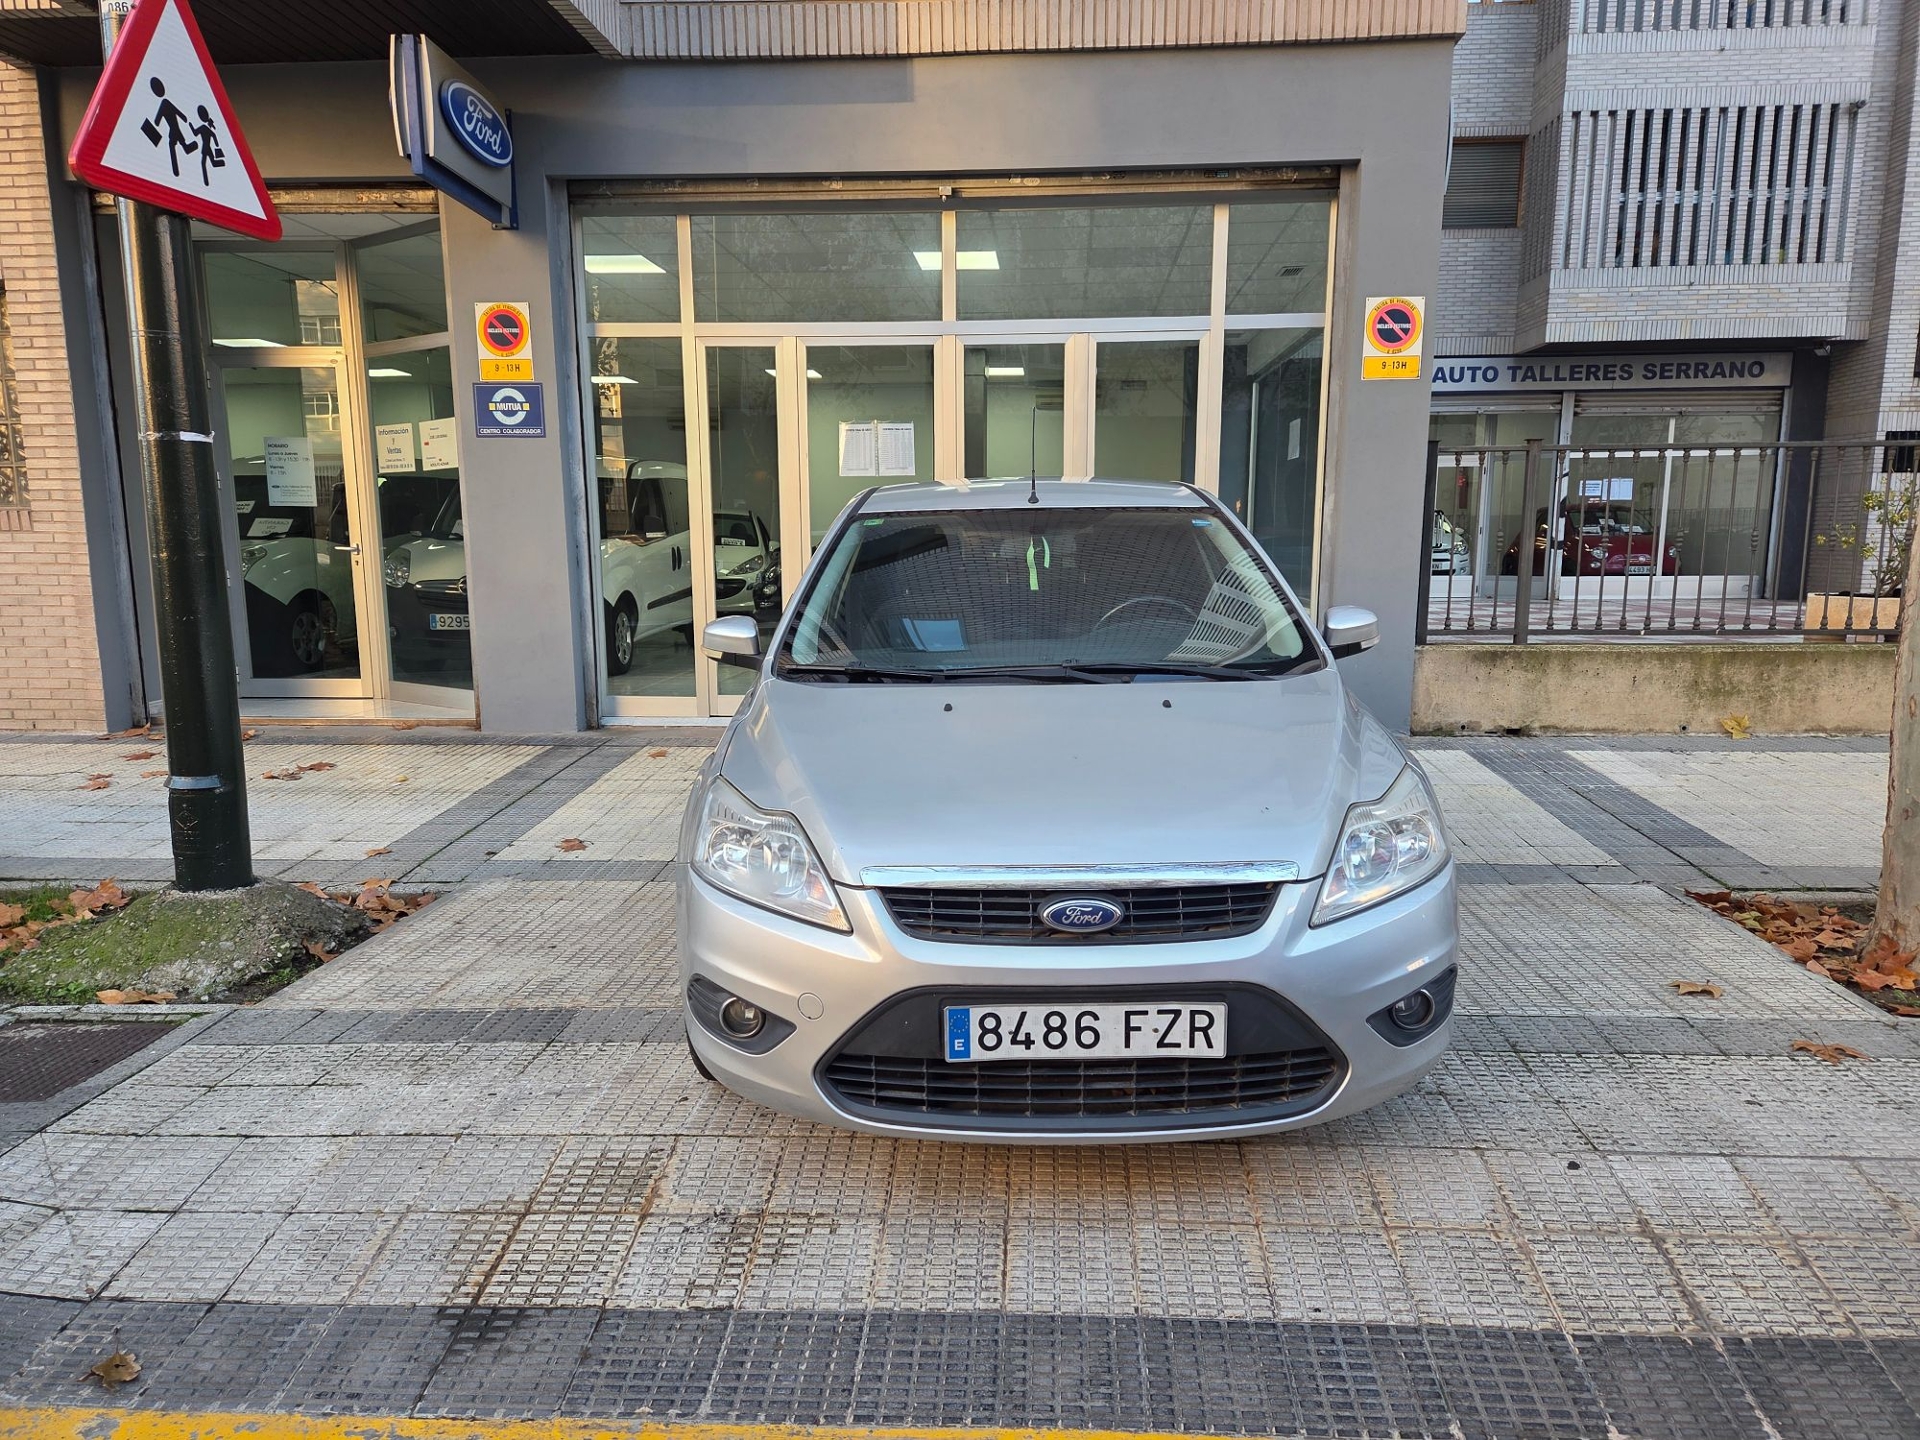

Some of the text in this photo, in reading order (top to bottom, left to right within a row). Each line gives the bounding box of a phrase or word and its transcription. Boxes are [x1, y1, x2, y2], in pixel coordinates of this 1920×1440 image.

[463, 95, 502, 154] Ford
[1432, 360, 1765, 383] AUTO TALLERES SERRANO
[496, 402, 522, 411] MUTUA
[378, 427, 409, 436] Información
[438, 615, 470, 628] 9295
[1061, 906, 1103, 925] Ford
[954, 1008, 1215, 1051] E 8486 FZR
